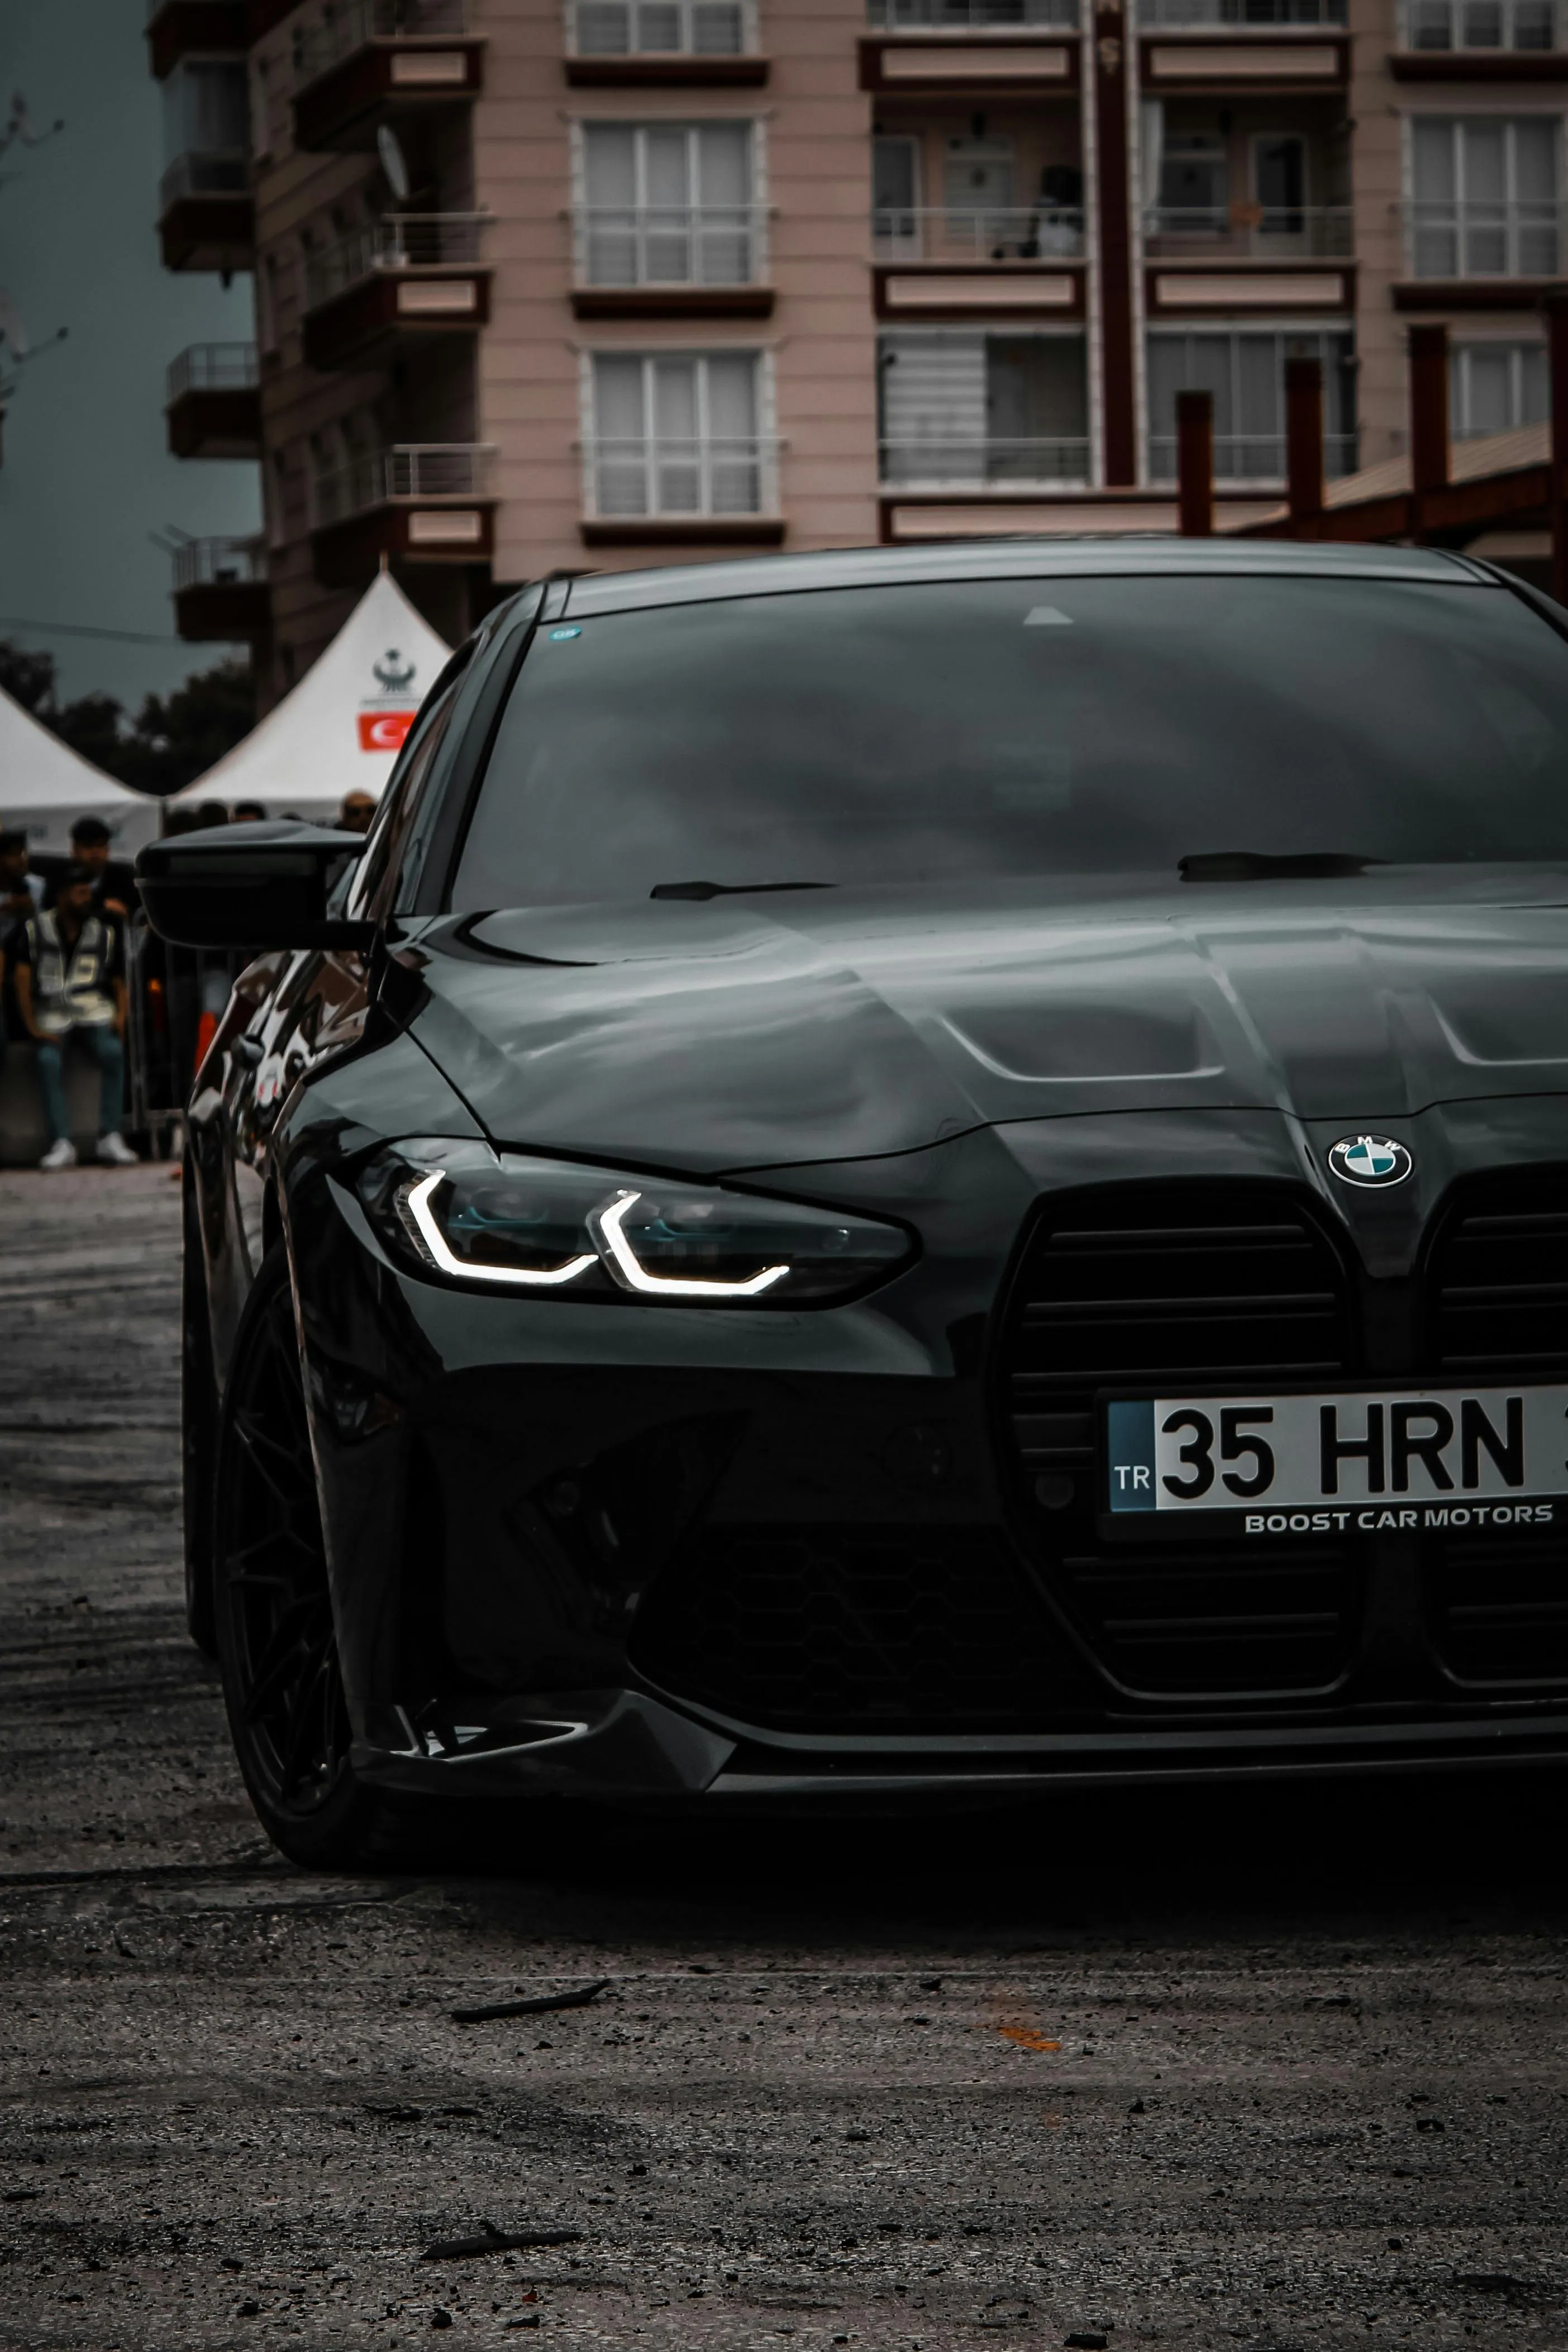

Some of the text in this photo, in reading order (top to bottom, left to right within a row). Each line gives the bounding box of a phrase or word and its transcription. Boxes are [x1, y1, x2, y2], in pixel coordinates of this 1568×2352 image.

[1334, 1136, 1401, 1154] BMW
[1161, 1404, 1275, 1499] 35
[1320, 1396, 1524, 1494] HRN
[1114, 1465, 1150, 1489] TR
[1245, 1504, 1553, 1533] BOOST CAR MOTORS
